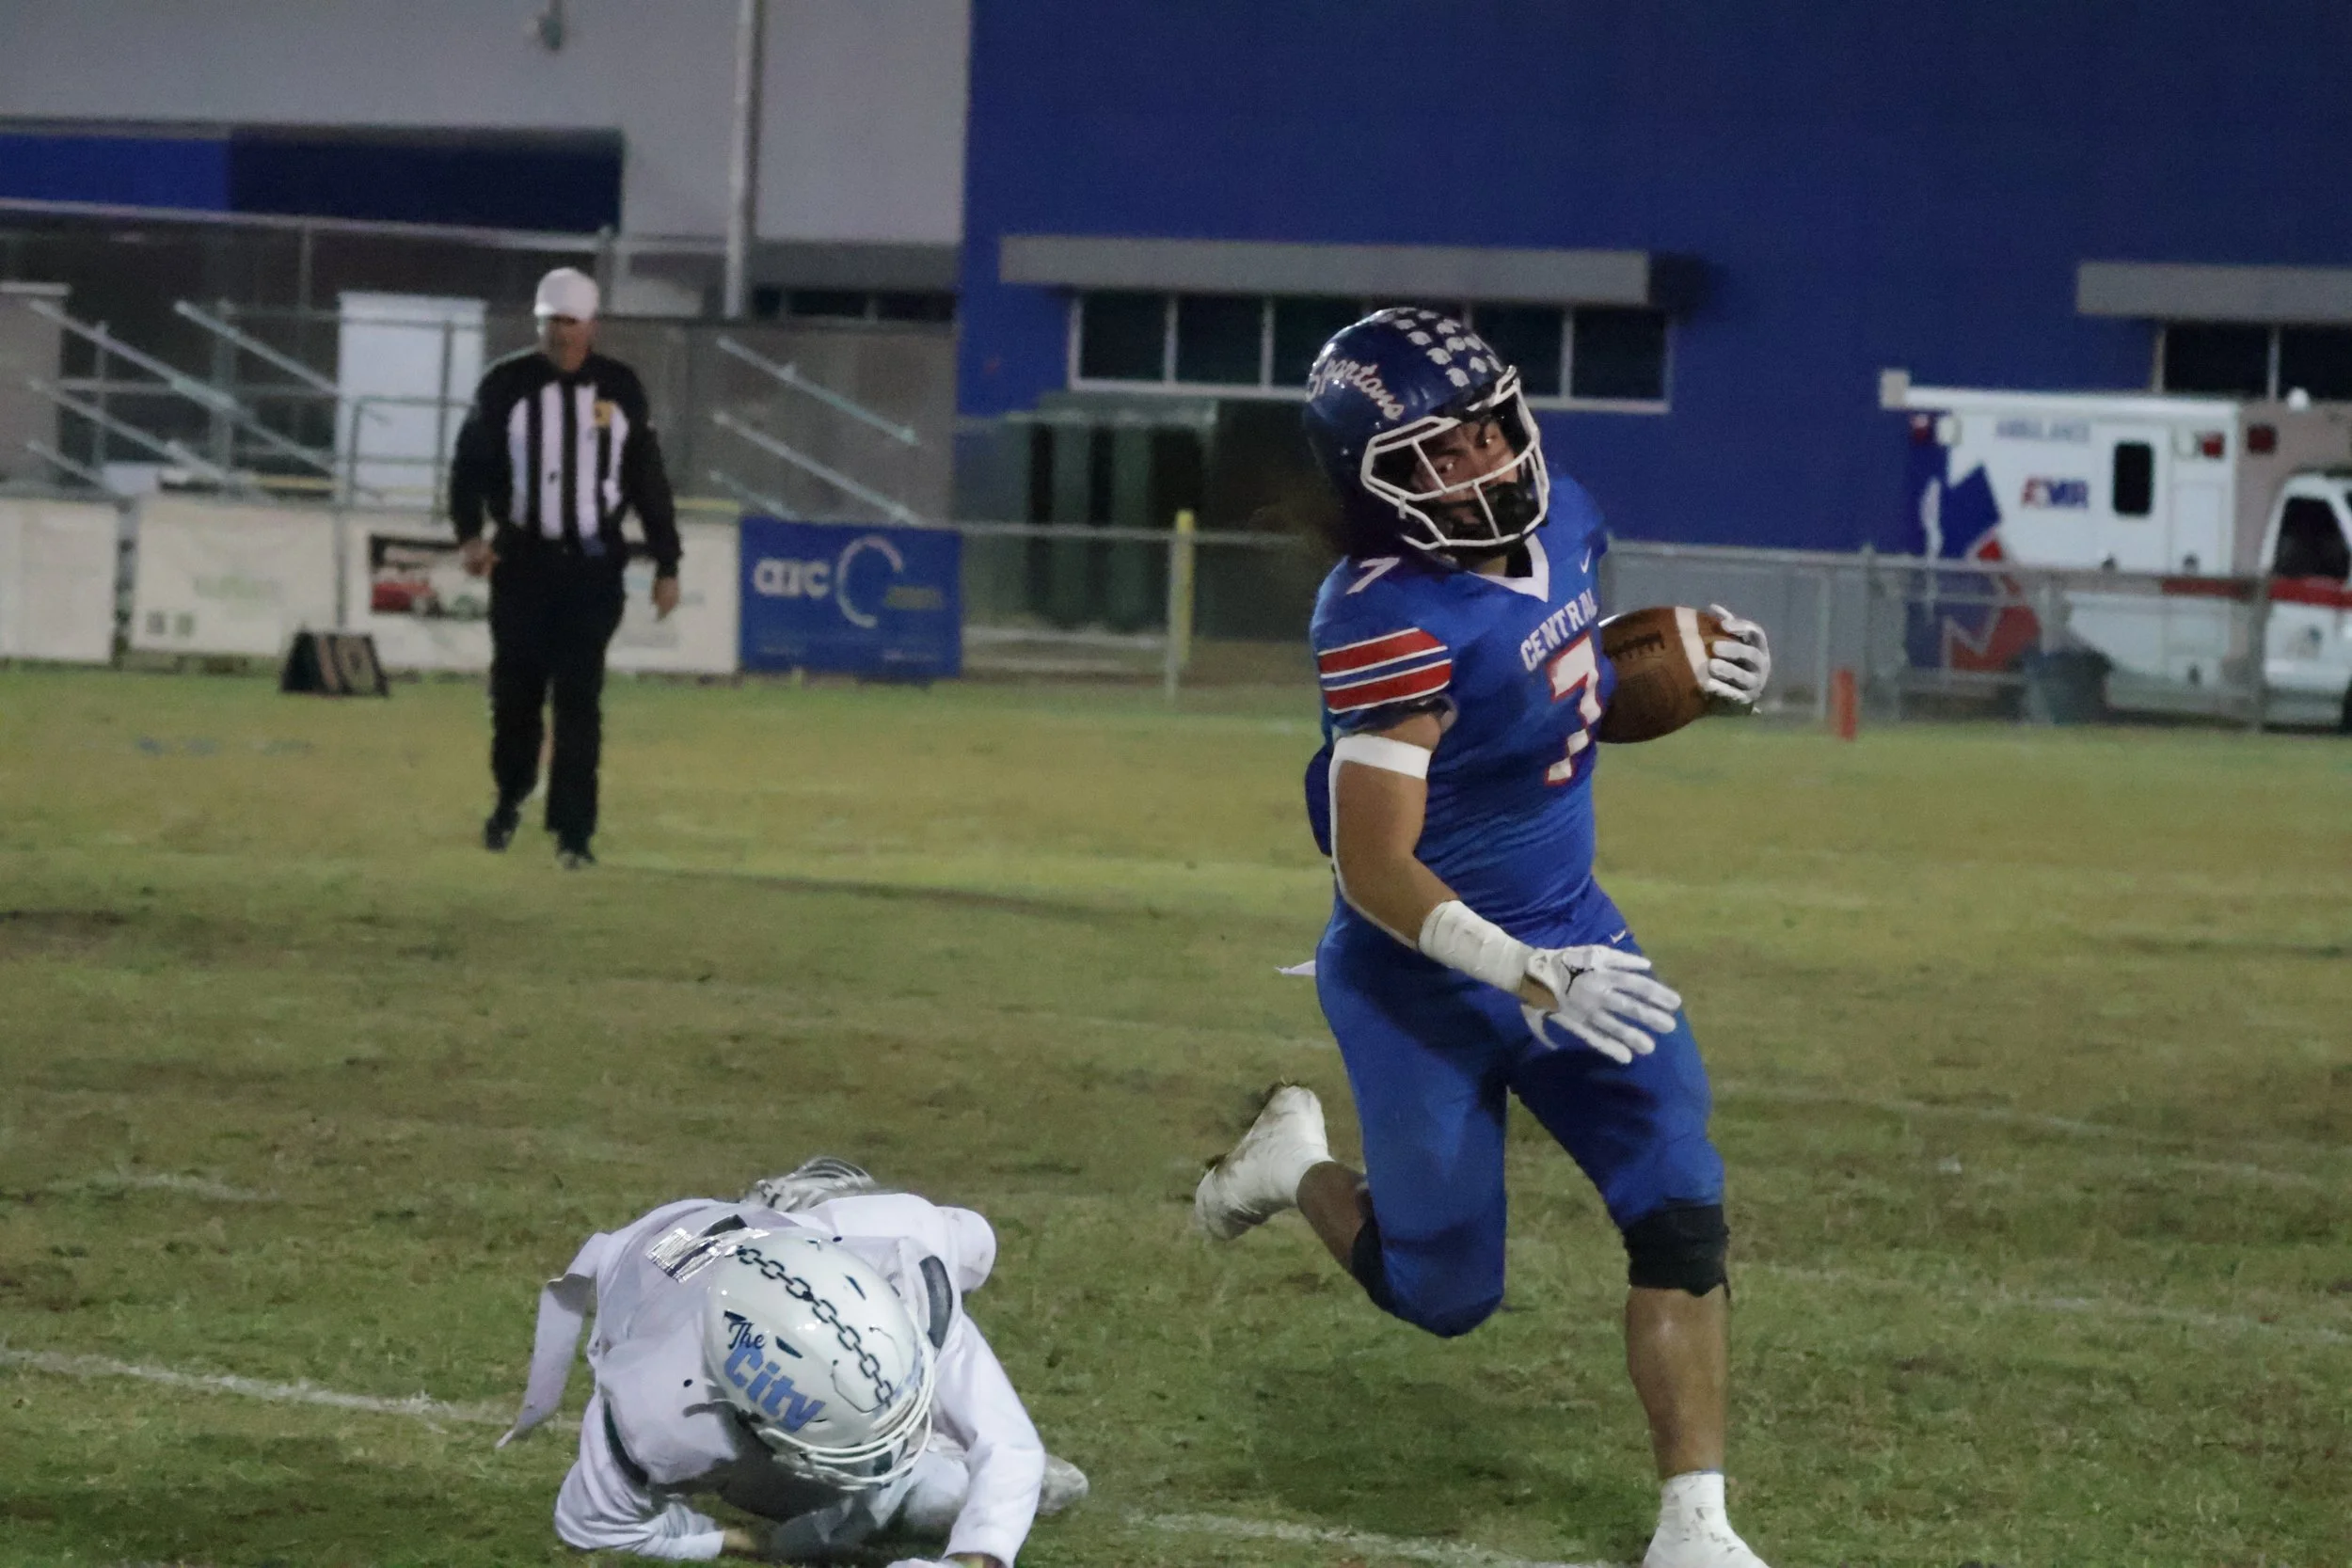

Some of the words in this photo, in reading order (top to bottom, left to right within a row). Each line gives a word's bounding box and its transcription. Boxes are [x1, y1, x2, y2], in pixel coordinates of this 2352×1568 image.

[1346, 557, 1400, 594] 7
[1519, 588, 1597, 673] CENTRAL
[1544, 629, 1601, 787] 7
[727, 1321, 765, 1351] The
[723, 1345, 826, 1433] City
